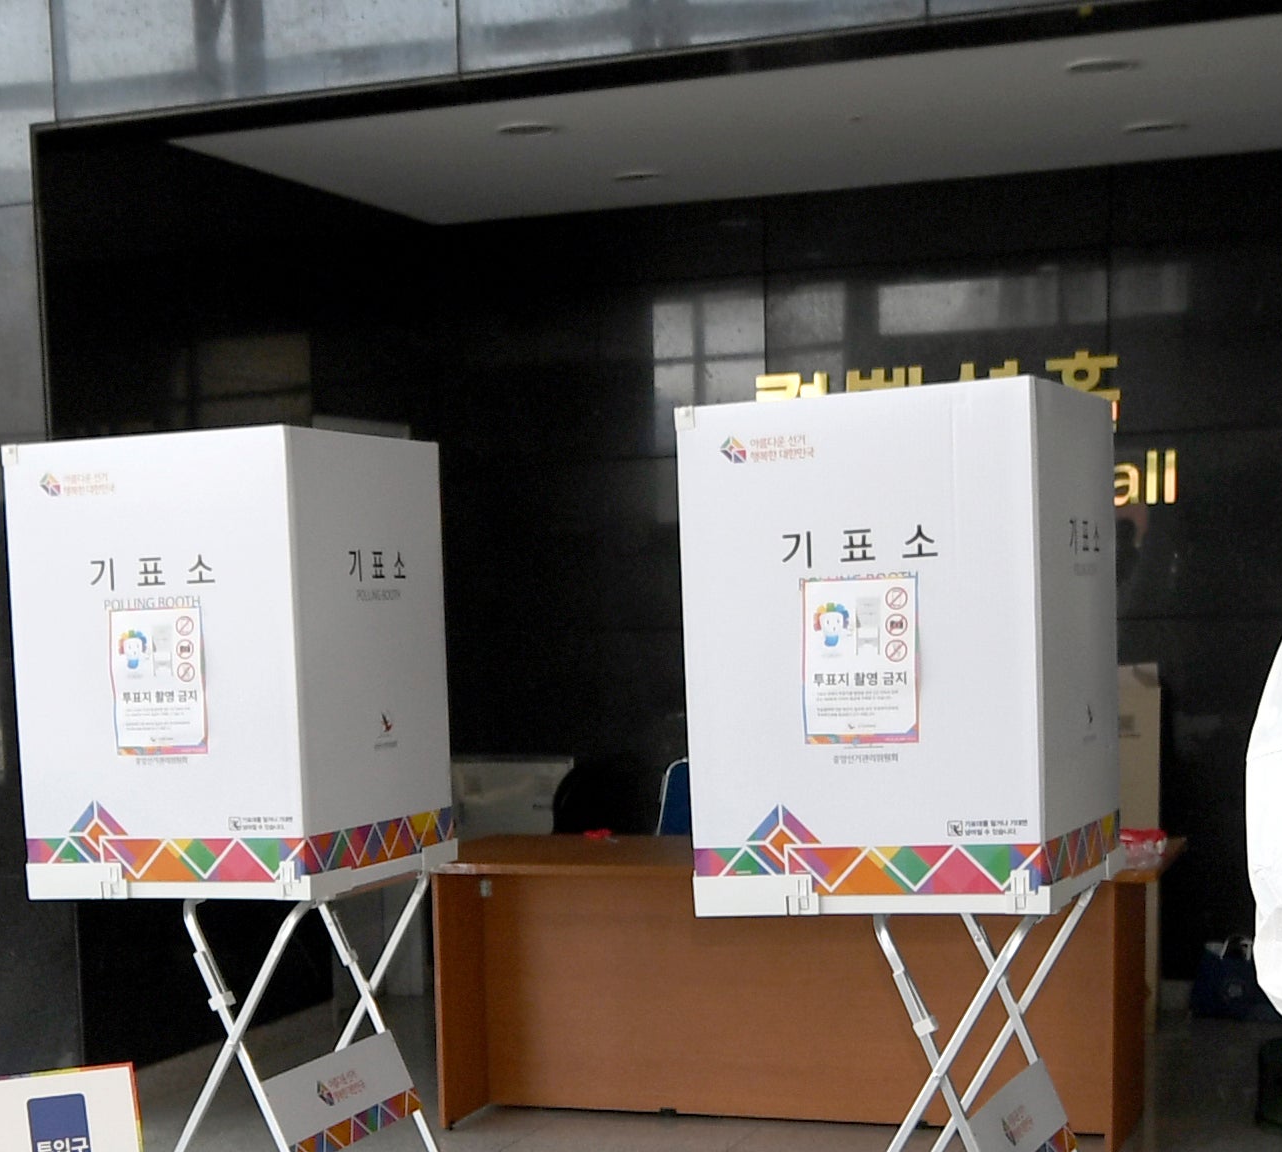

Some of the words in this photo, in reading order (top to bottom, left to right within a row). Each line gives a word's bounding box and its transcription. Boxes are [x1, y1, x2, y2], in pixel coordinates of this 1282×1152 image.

[1113, 448, 1177, 507] all
[348, 549, 406, 582] 기표소
[781, 524, 939, 569] 기표소
[90, 553, 216, 592] 기표소
[813, 673, 849, 687] 투표지
[854, 672, 878, 687] 촬영
[882, 671, 907, 686] 금지
